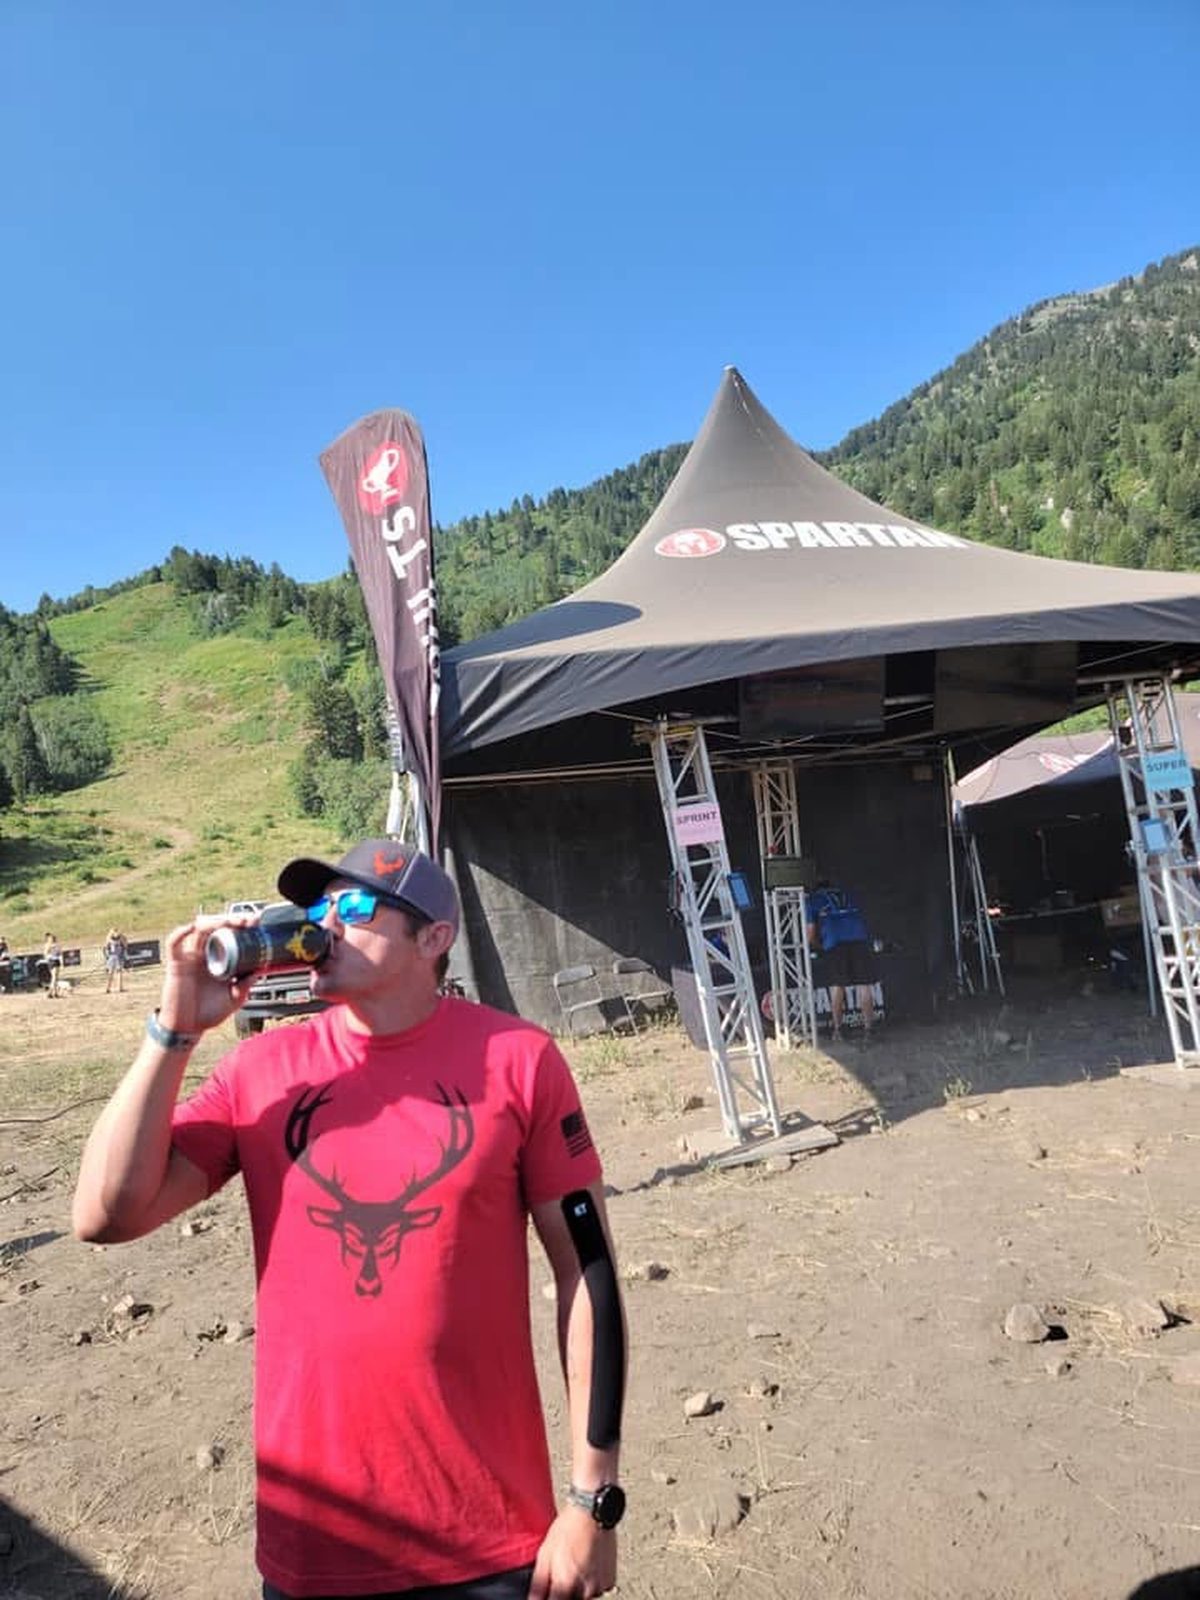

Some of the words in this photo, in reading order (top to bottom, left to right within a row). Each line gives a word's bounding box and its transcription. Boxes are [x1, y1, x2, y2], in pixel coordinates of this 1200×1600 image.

[725, 521, 970, 550] SPARTAN
[1146, 759, 1187, 773] SUPER
[676, 810, 718, 825] SPRINT
